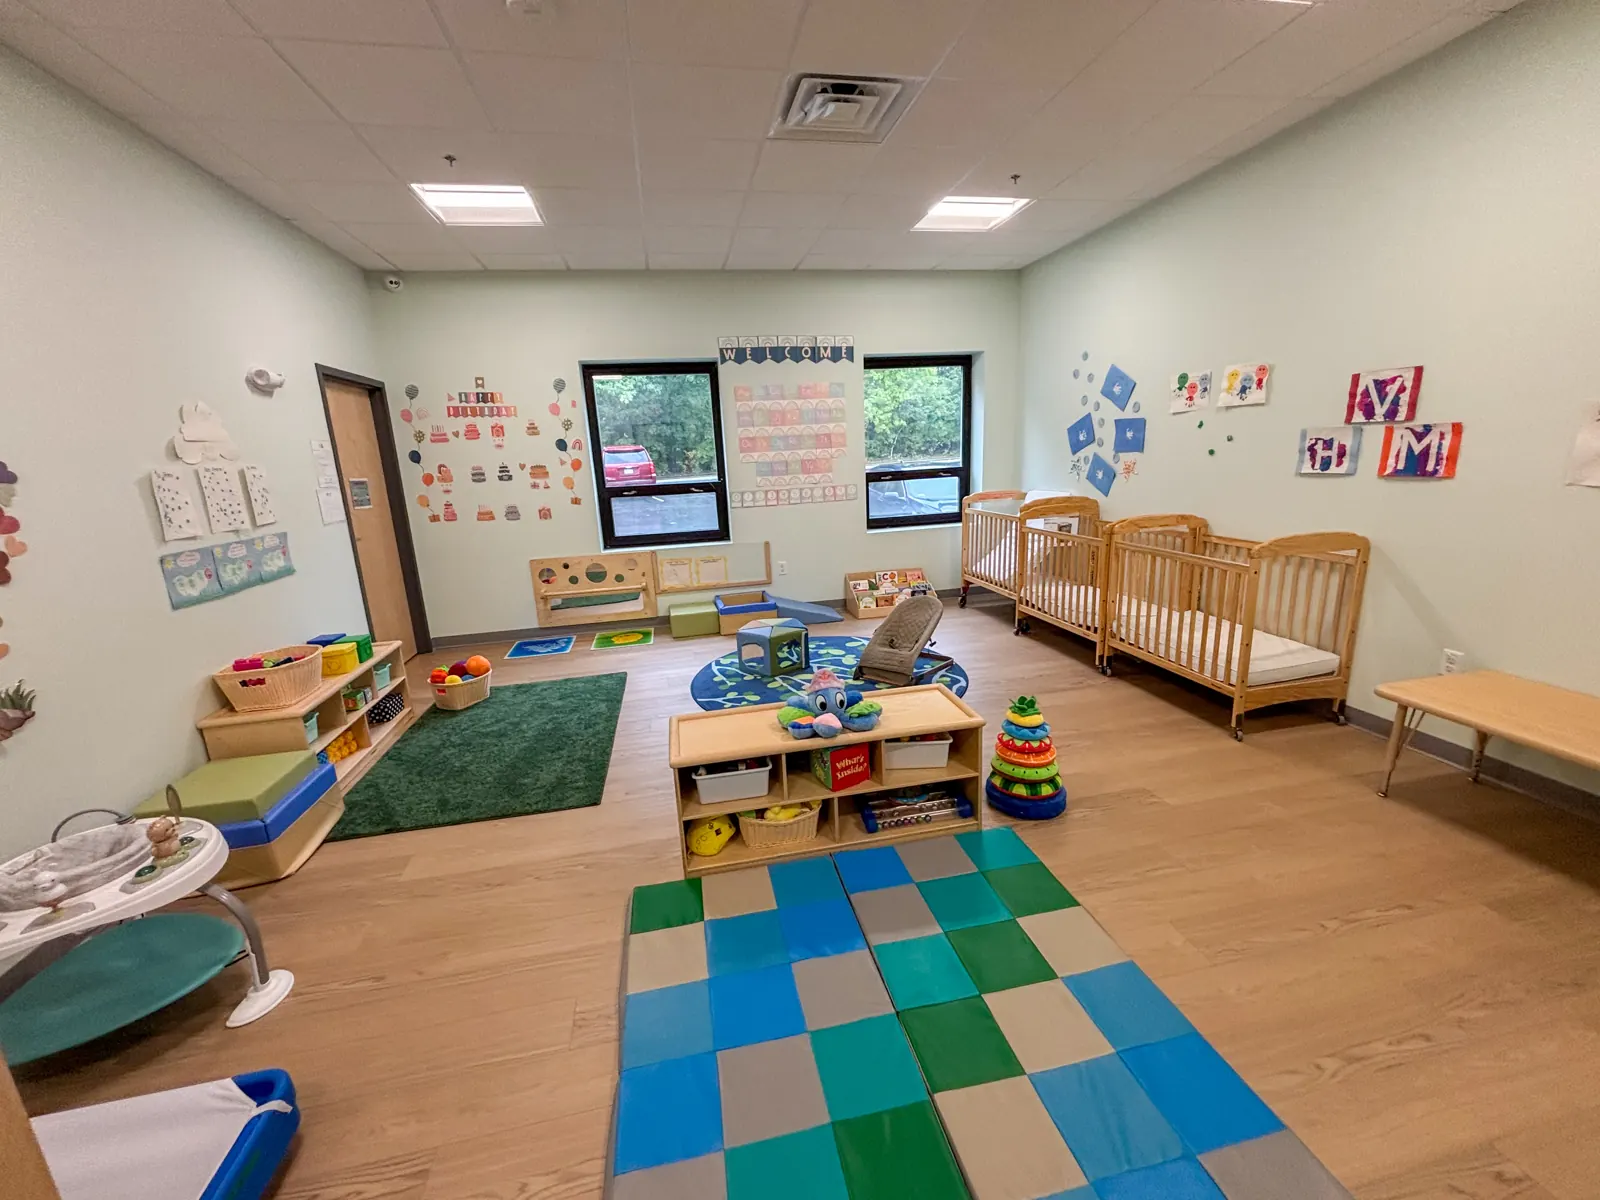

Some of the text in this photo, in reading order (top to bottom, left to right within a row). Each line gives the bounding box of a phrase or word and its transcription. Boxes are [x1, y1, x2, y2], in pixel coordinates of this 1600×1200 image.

[723, 347, 847, 359] WELCOME
[1365, 378, 1403, 417] V
[1314, 438, 1339, 470] H
[1396, 427, 1440, 471] M
[836, 753, 864, 769] What's
[836, 763, 867, 780] Inside?
